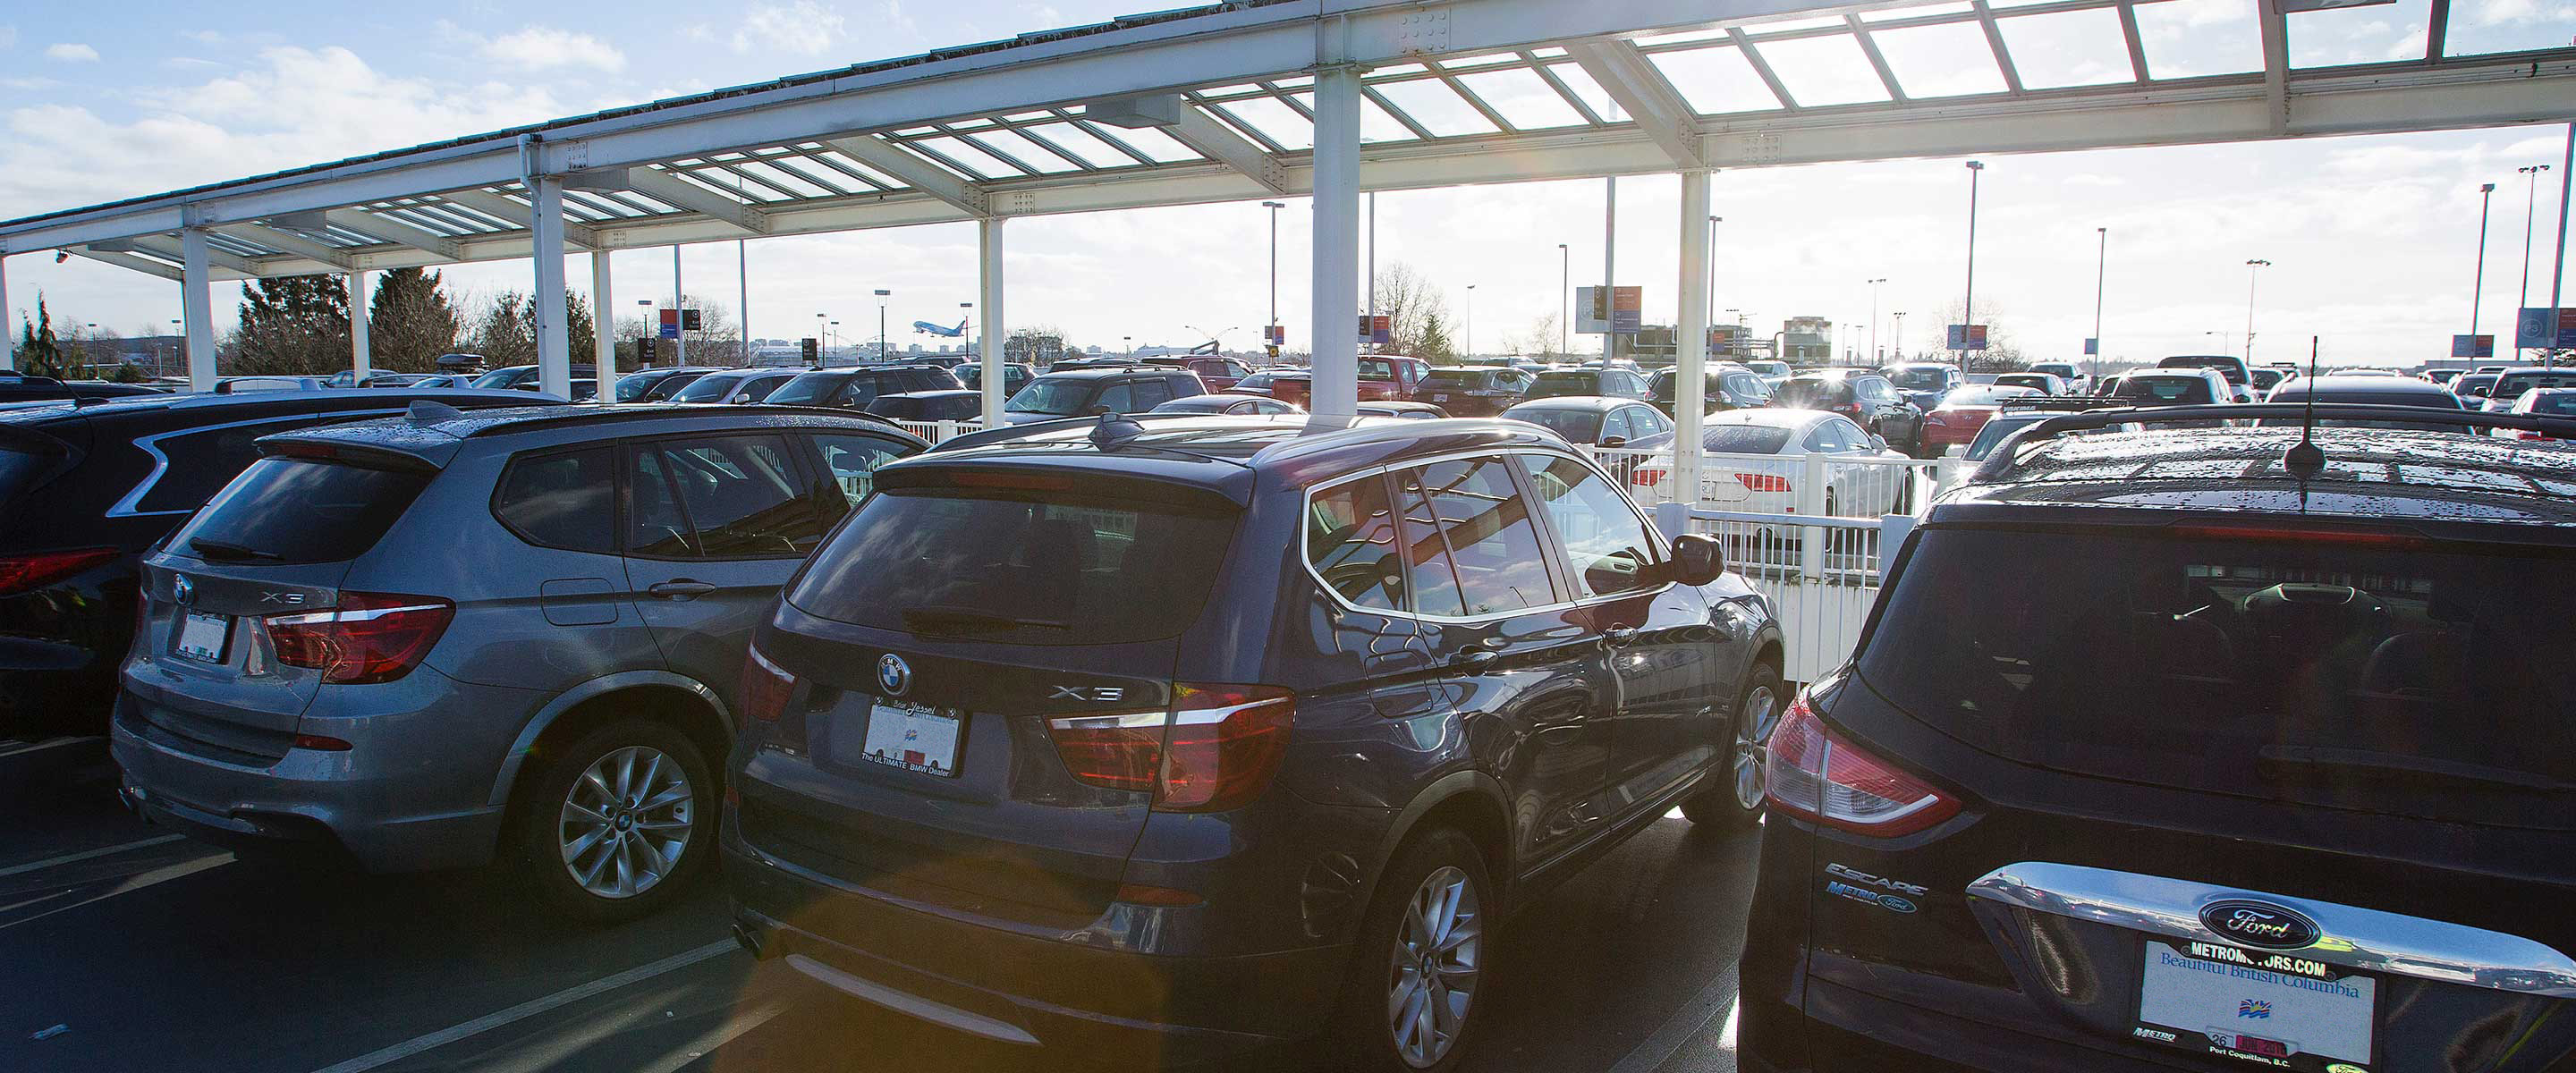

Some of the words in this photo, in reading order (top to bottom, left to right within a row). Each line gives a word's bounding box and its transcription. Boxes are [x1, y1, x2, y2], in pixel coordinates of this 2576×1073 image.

[261, 591, 305, 604] X3
[1047, 685, 1123, 701] X3
[906, 702, 936, 715] Jessel
[861, 752, 873, 762] The
[874, 755, 907, 769] ULTIMATE
[910, 765, 928, 773] BMW
[928, 766, 950, 777] Dealer
[1825, 862, 1929, 896] ESCAPE
[1826, 881, 1878, 900] METRO
[1885, 897, 1908, 909] Ford
[2227, 909, 2291, 939] Ford
[2191, 942, 2326, 977] METROMORS.COM
[2161, 952, 2225, 976] Beautiful
[2231, 965, 2278, 984] British
[2282, 974, 2360, 999] Columbia
[2133, 1027, 2176, 1041] METRO
[2212, 1034, 2227, 1046] 26
[2209, 1045, 2226, 1055] Port
[2228, 1050, 2272, 1065] Coquitlam,
[2273, 1058, 2291, 1068] B.C.
